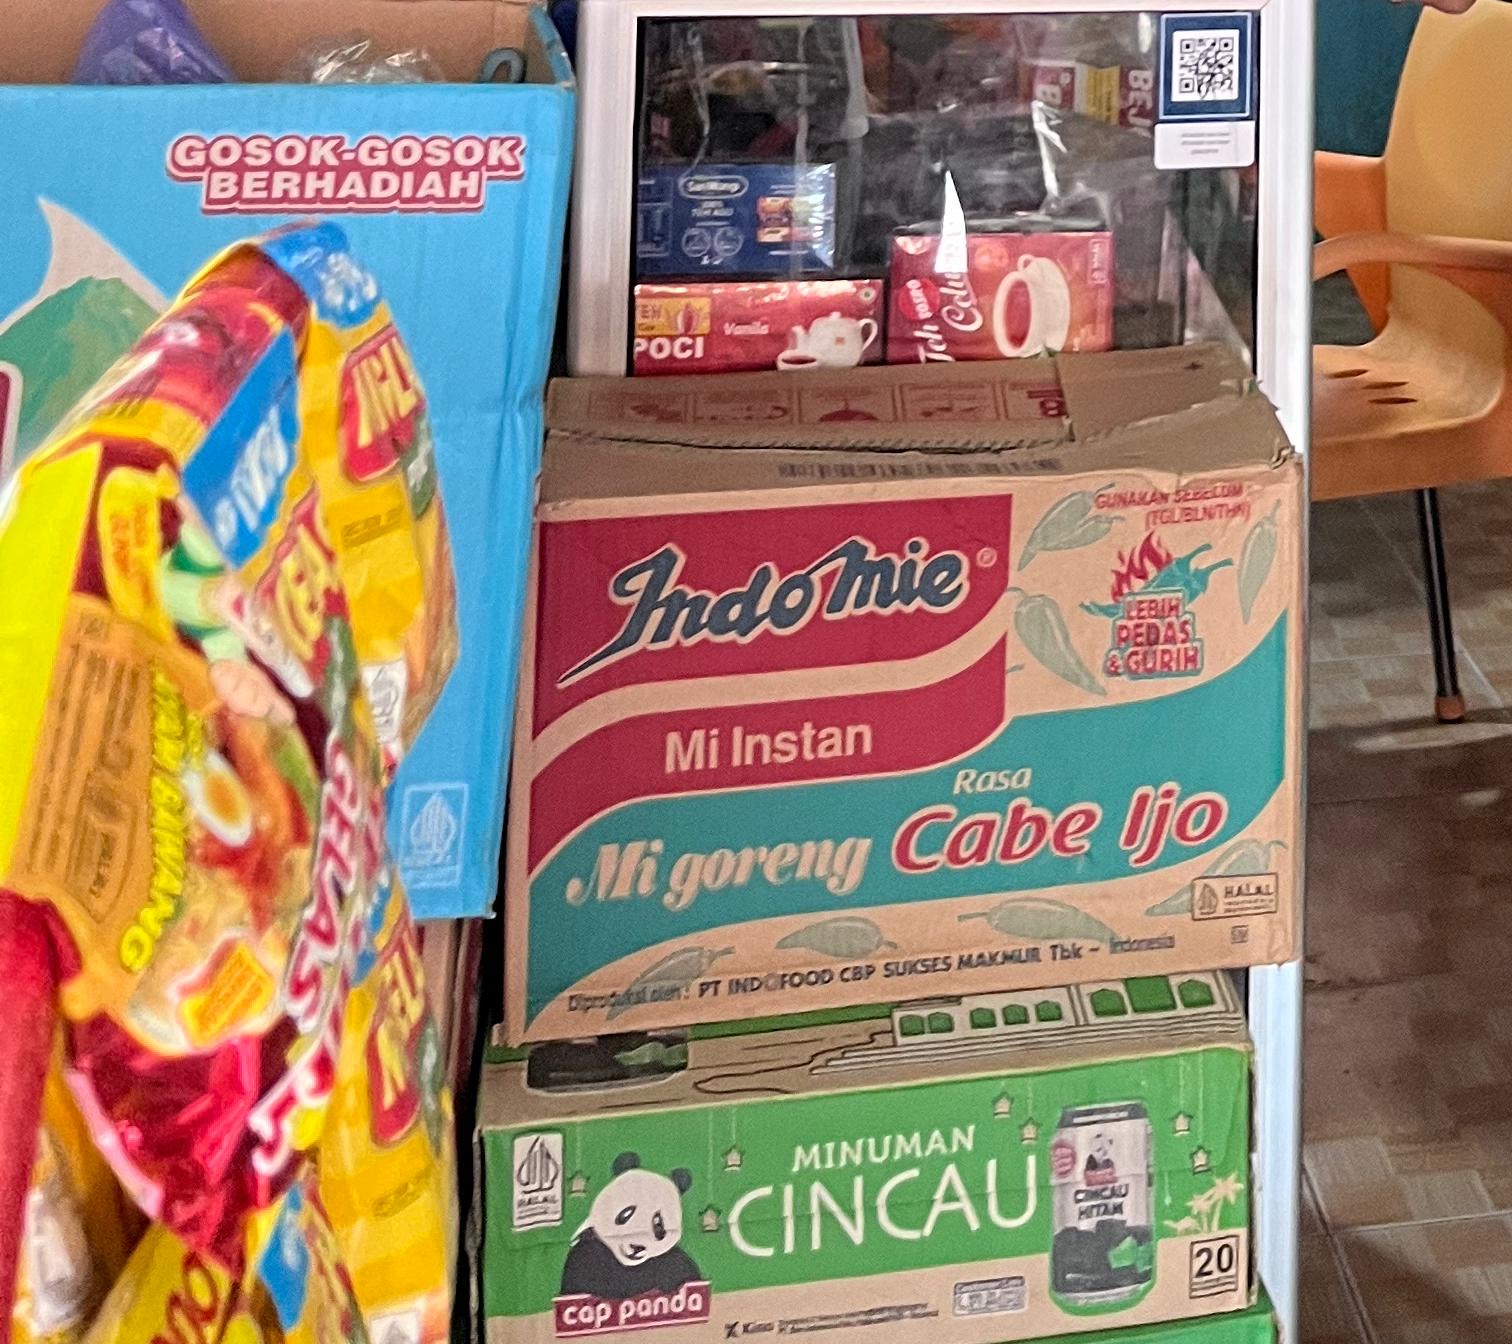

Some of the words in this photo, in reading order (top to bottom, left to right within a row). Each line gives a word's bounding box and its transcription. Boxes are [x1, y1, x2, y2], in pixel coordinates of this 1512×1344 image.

[171, 136, 523, 170] GOSOK-GOSOK
[207, 170, 482, 200] BERHADIAH
[555, 536, 971, 689] Indomie
[1116, 620, 1192, 646] PEDAS
[1126, 646, 1200, 673] GURIH
[665, 731, 724, 774] Mi
[731, 720, 872, 768] Instan
[952, 766, 1031, 794] Rasa
[892, 803, 1102, 872] Cabe
[1120, 785, 1229, 867] Ijo
[567, 844, 660, 905] Mi
[670, 836, 872, 908] goreng
[698, 980, 721, 998] PT
[727, 967, 834, 995] INDOFOOD
[838, 964, 876, 984] CBP
[882, 954, 952, 979] SUKSES
[1048, 942, 1081, 960] Tbk
[792, 1124, 975, 1173] MINUMAN
[727, 1153, 1038, 1257] CINCAU
[1192, 1238, 1236, 1279] 20
[561, 1300, 612, 1328] cap
[617, 1290, 704, 1323] panda
